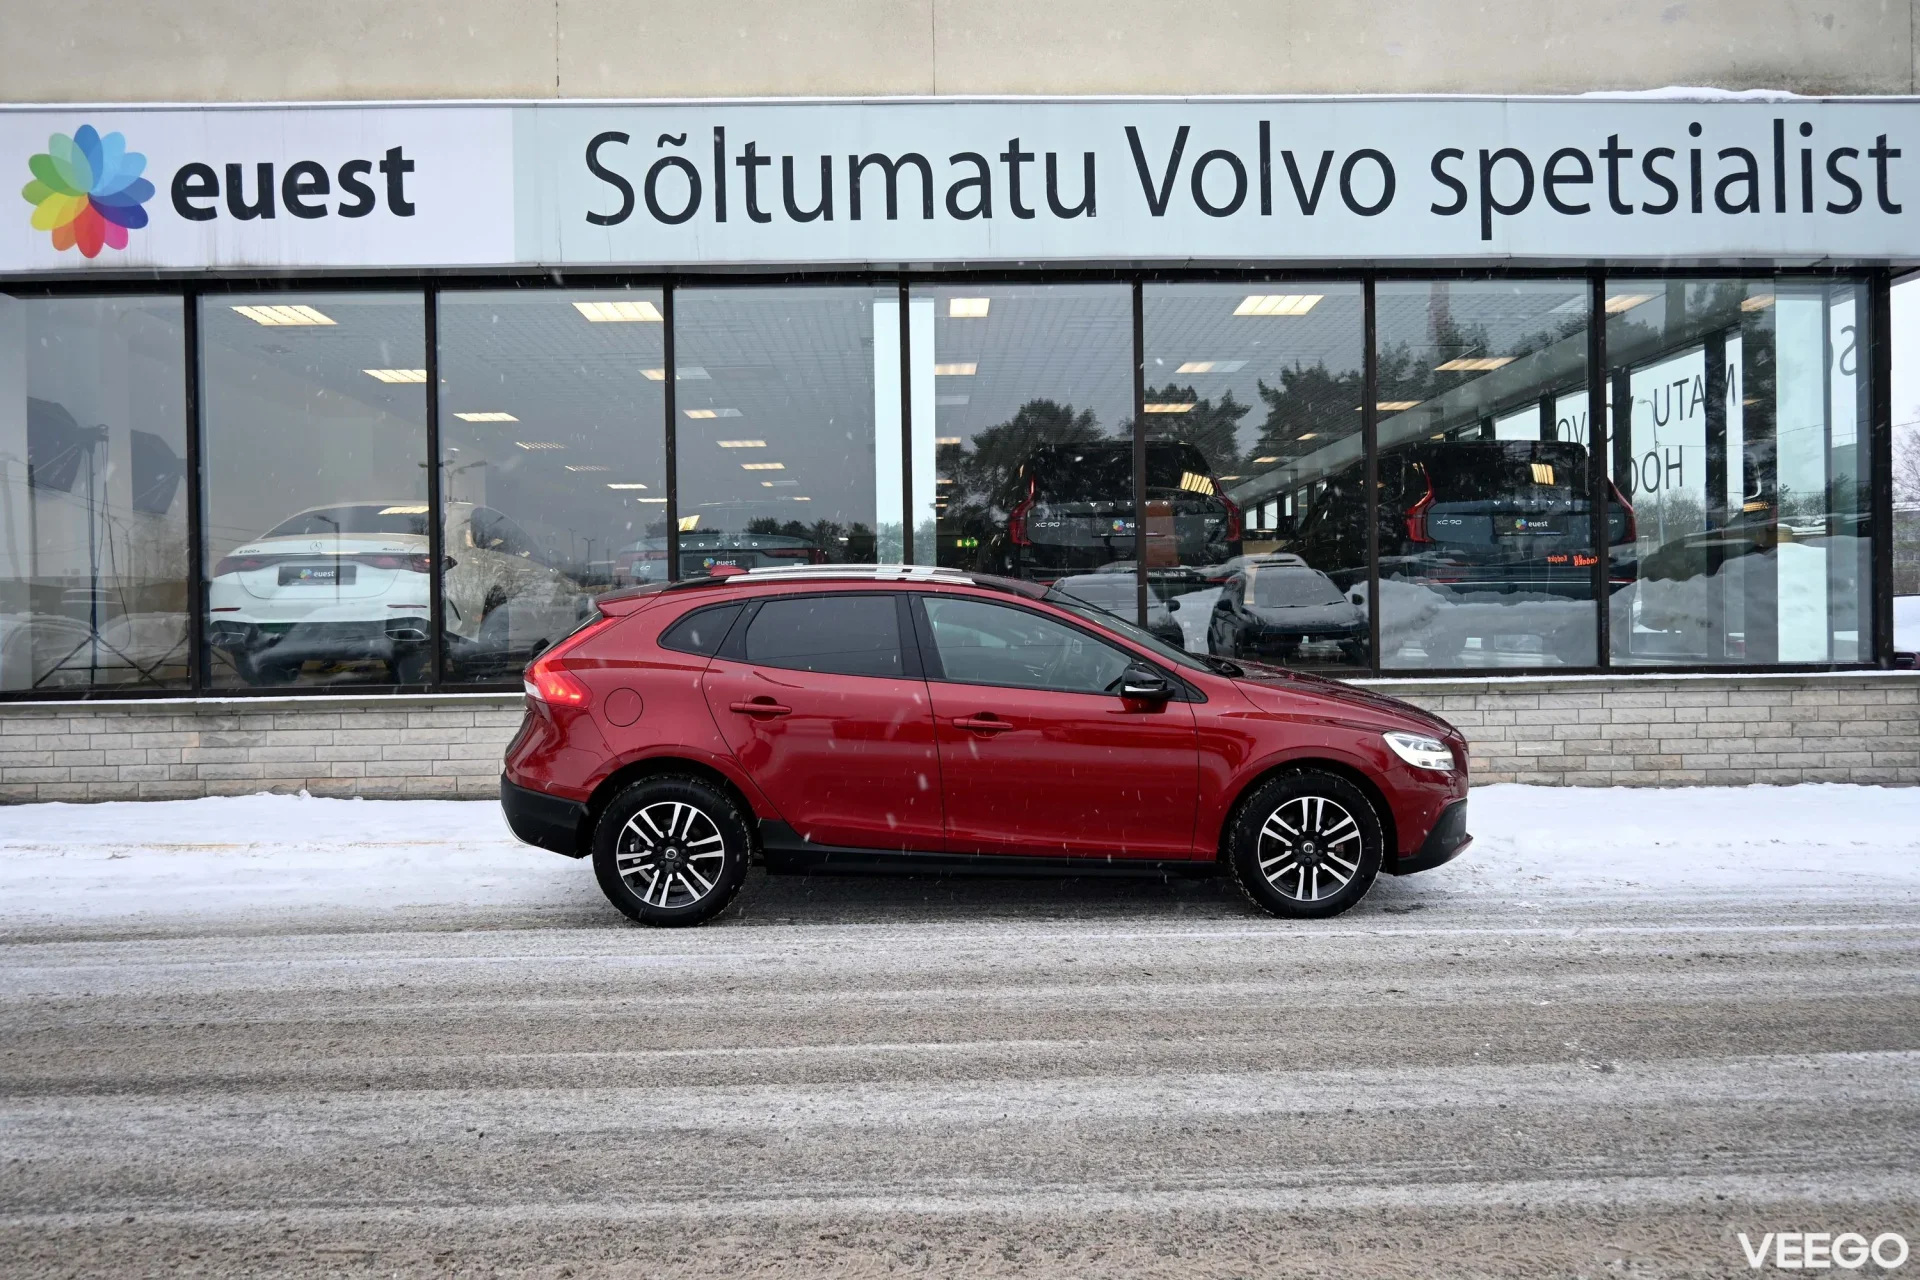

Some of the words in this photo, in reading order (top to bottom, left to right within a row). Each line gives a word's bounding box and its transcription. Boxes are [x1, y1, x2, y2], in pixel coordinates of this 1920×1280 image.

[171, 146, 416, 221] euest
[585, 126, 1097, 226] Sõltumatu
[1124, 120, 1396, 218] Volvo
[1430, 118, 1903, 241] spetsialist
[1528, 519, 1548, 528] euest
[716, 559, 737, 567] euest
[313, 569, 335, 578] euest
